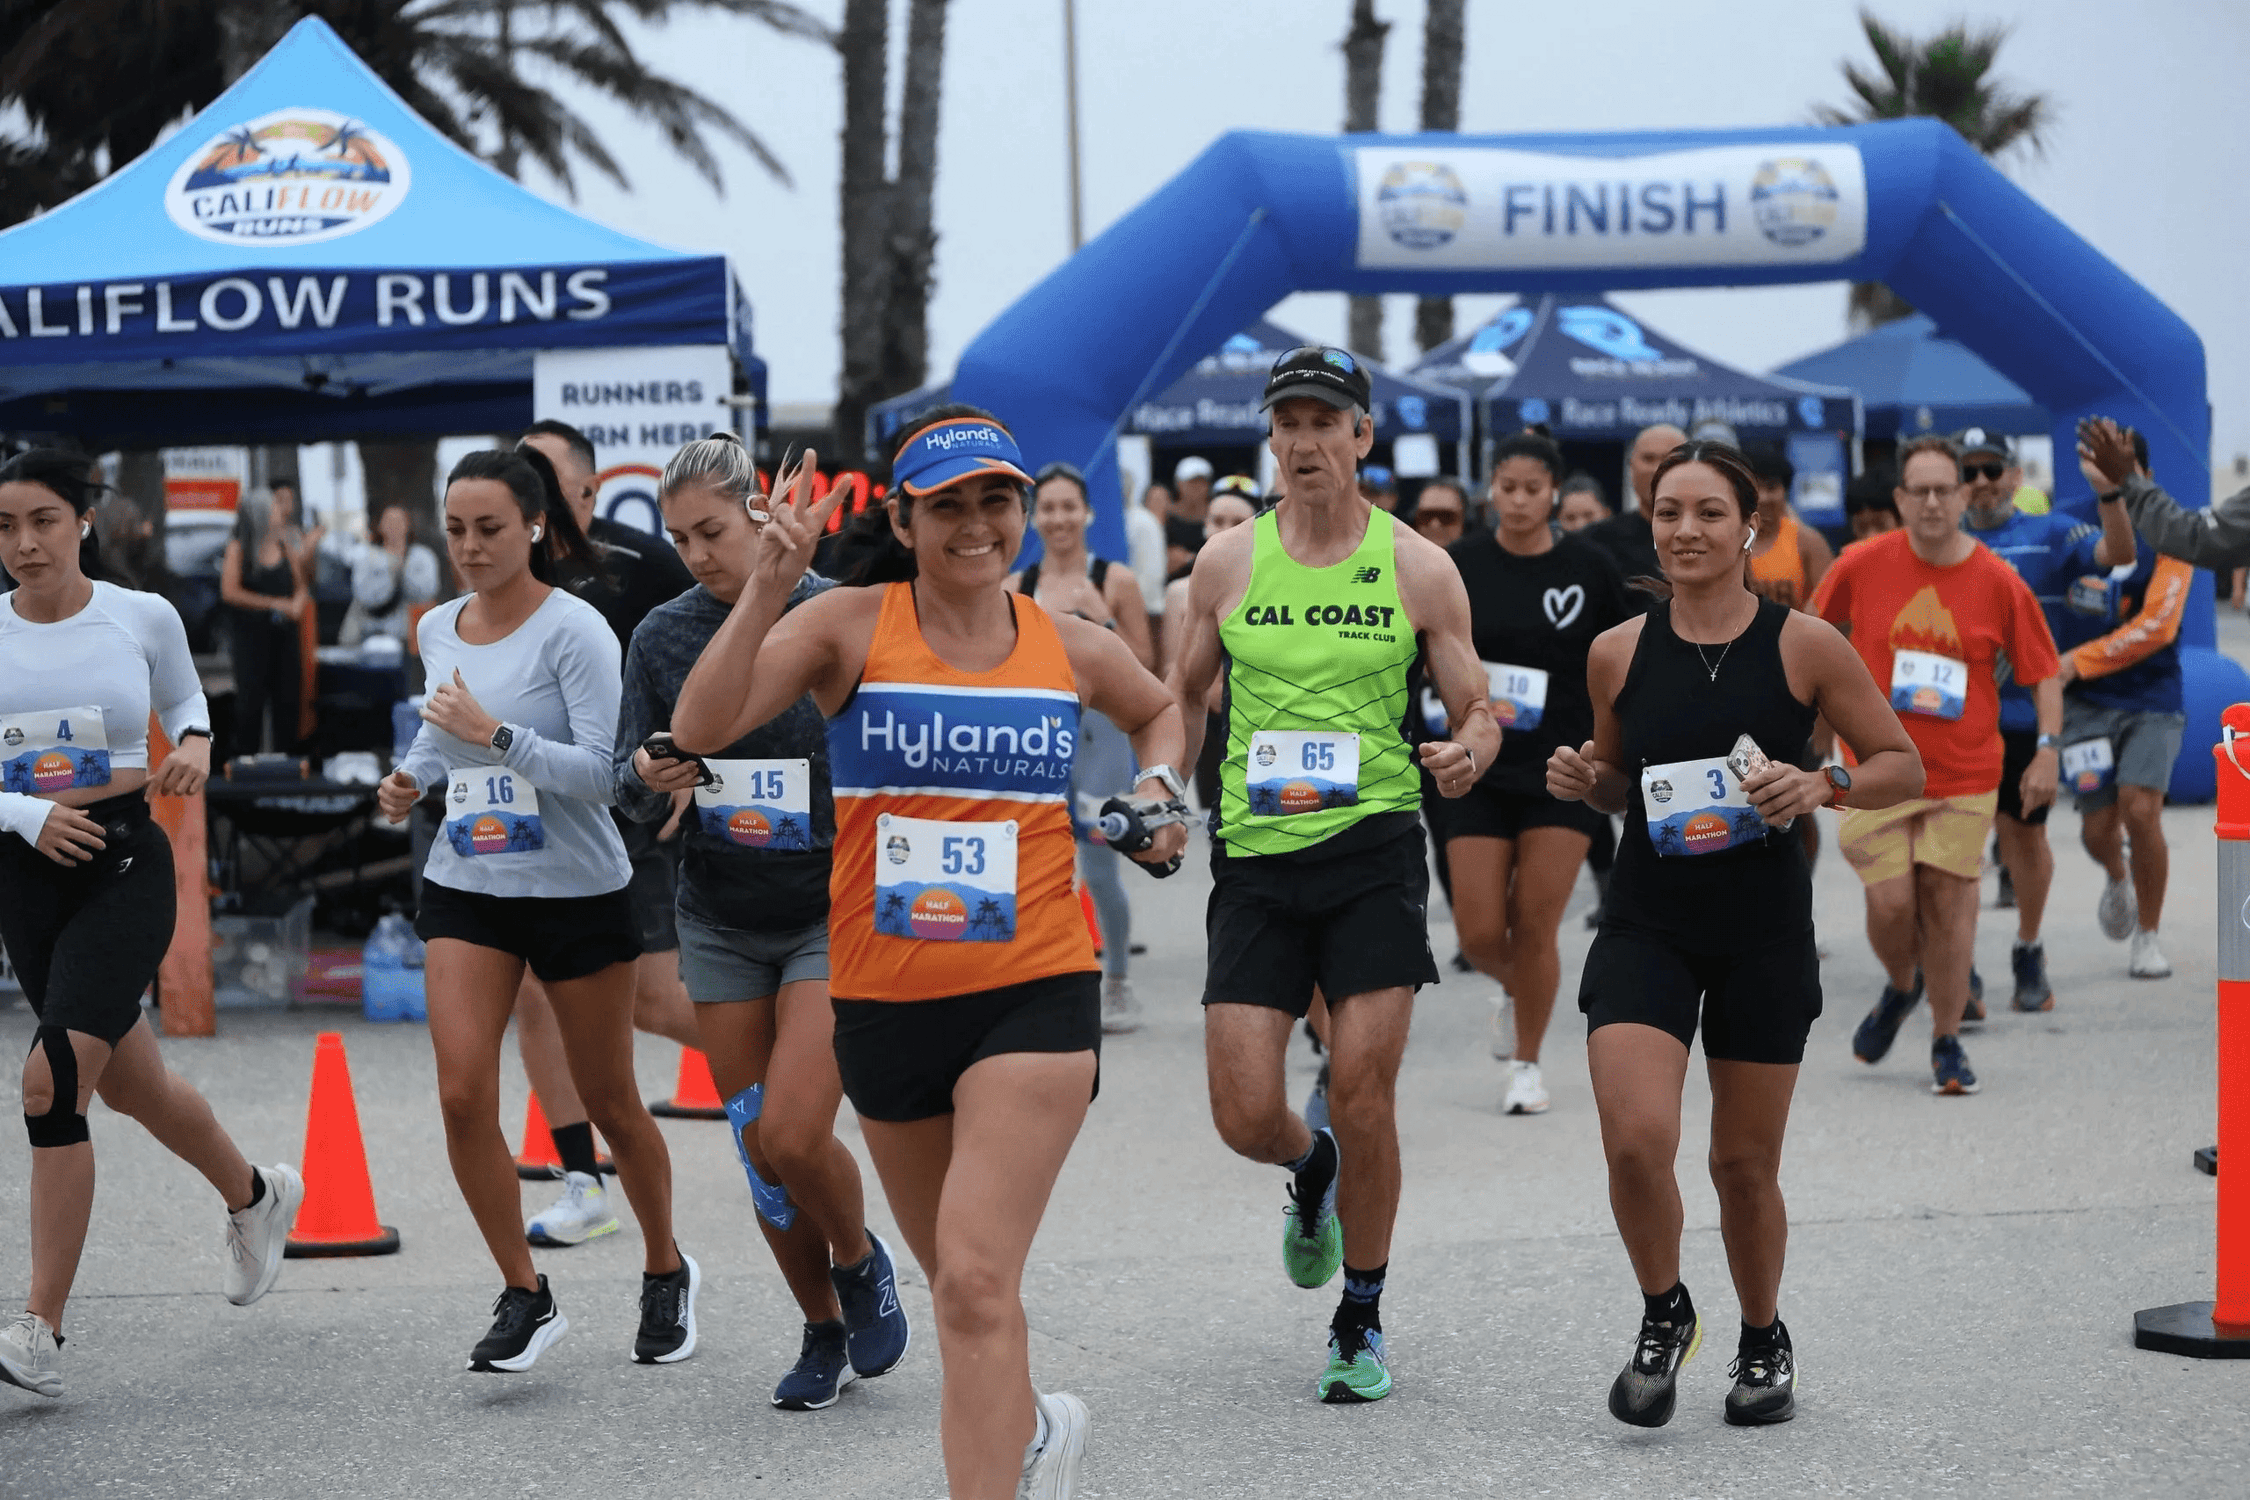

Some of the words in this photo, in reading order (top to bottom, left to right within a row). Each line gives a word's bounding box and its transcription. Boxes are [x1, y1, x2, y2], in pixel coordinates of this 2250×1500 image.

[193, 185, 381, 217] CALIFLOW
[1503, 183, 1727, 235] FINISH
[232, 217, 323, 236] RUNS
[376, 269, 611, 327] RUNS
[562, 381, 704, 406] RUNNERS
[926, 427, 999, 450] Hyland's
[1245, 605, 1294, 626] CAL
[1305, 604, 1395, 628] COAST
[1338, 631, 1370, 640] TRACK
[1373, 633, 1396, 643] CLUB
[1507, 674, 1528, 694] 10
[1932, 664, 1953, 683] 12
[57, 719, 73, 741] 4
[861, 709, 1073, 768] Hyland's
[932, 756, 1069, 779] NATURALS
[1301, 741, 1335, 771] 65
[34, 769, 73, 779] MARATHON
[751, 770, 784, 799] 15
[1706, 769, 1726, 800] 3
[486, 775, 514, 805] 16
[472, 833, 506, 842] MARATHON
[729, 826, 769, 835] MARATHON
[1684, 829, 1728, 842] MARATHON
[1694, 822, 1714, 831] HALF
[942, 836, 986, 875] 53
[925, 900, 950, 910] HALF
[911, 912, 965, 923] MARATHON
